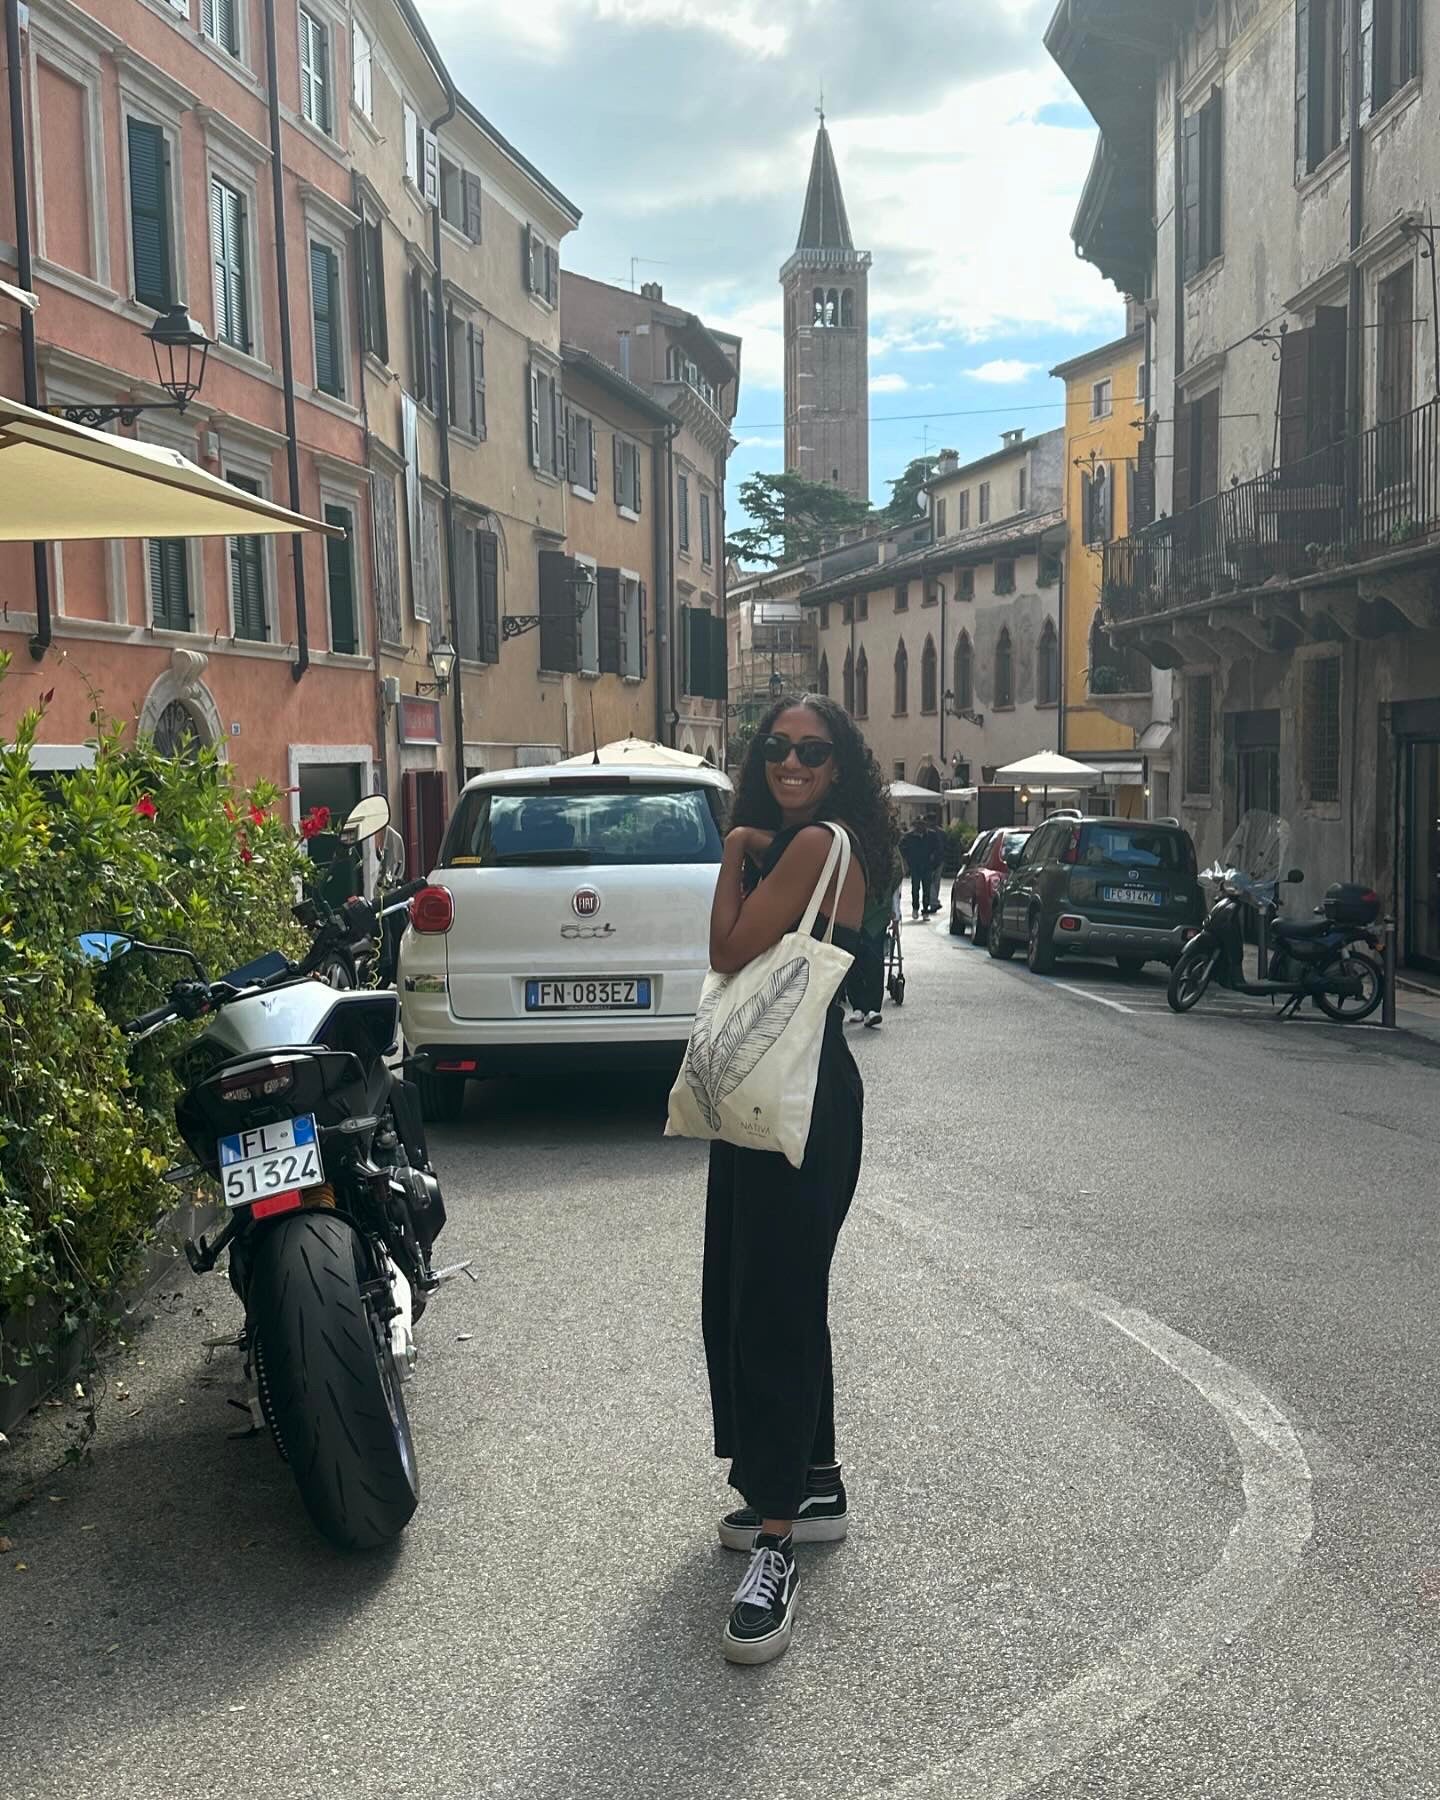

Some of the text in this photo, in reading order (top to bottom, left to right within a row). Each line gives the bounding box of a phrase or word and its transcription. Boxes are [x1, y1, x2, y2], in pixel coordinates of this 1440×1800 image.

[578, 897, 594, 910] FIAT
[541, 982, 635, 1004] FN 083EZ
[740, 1121, 771, 1135] NATIVA
[241, 1128, 278, 1158] FL
[227, 1149, 318, 1199] 51324
